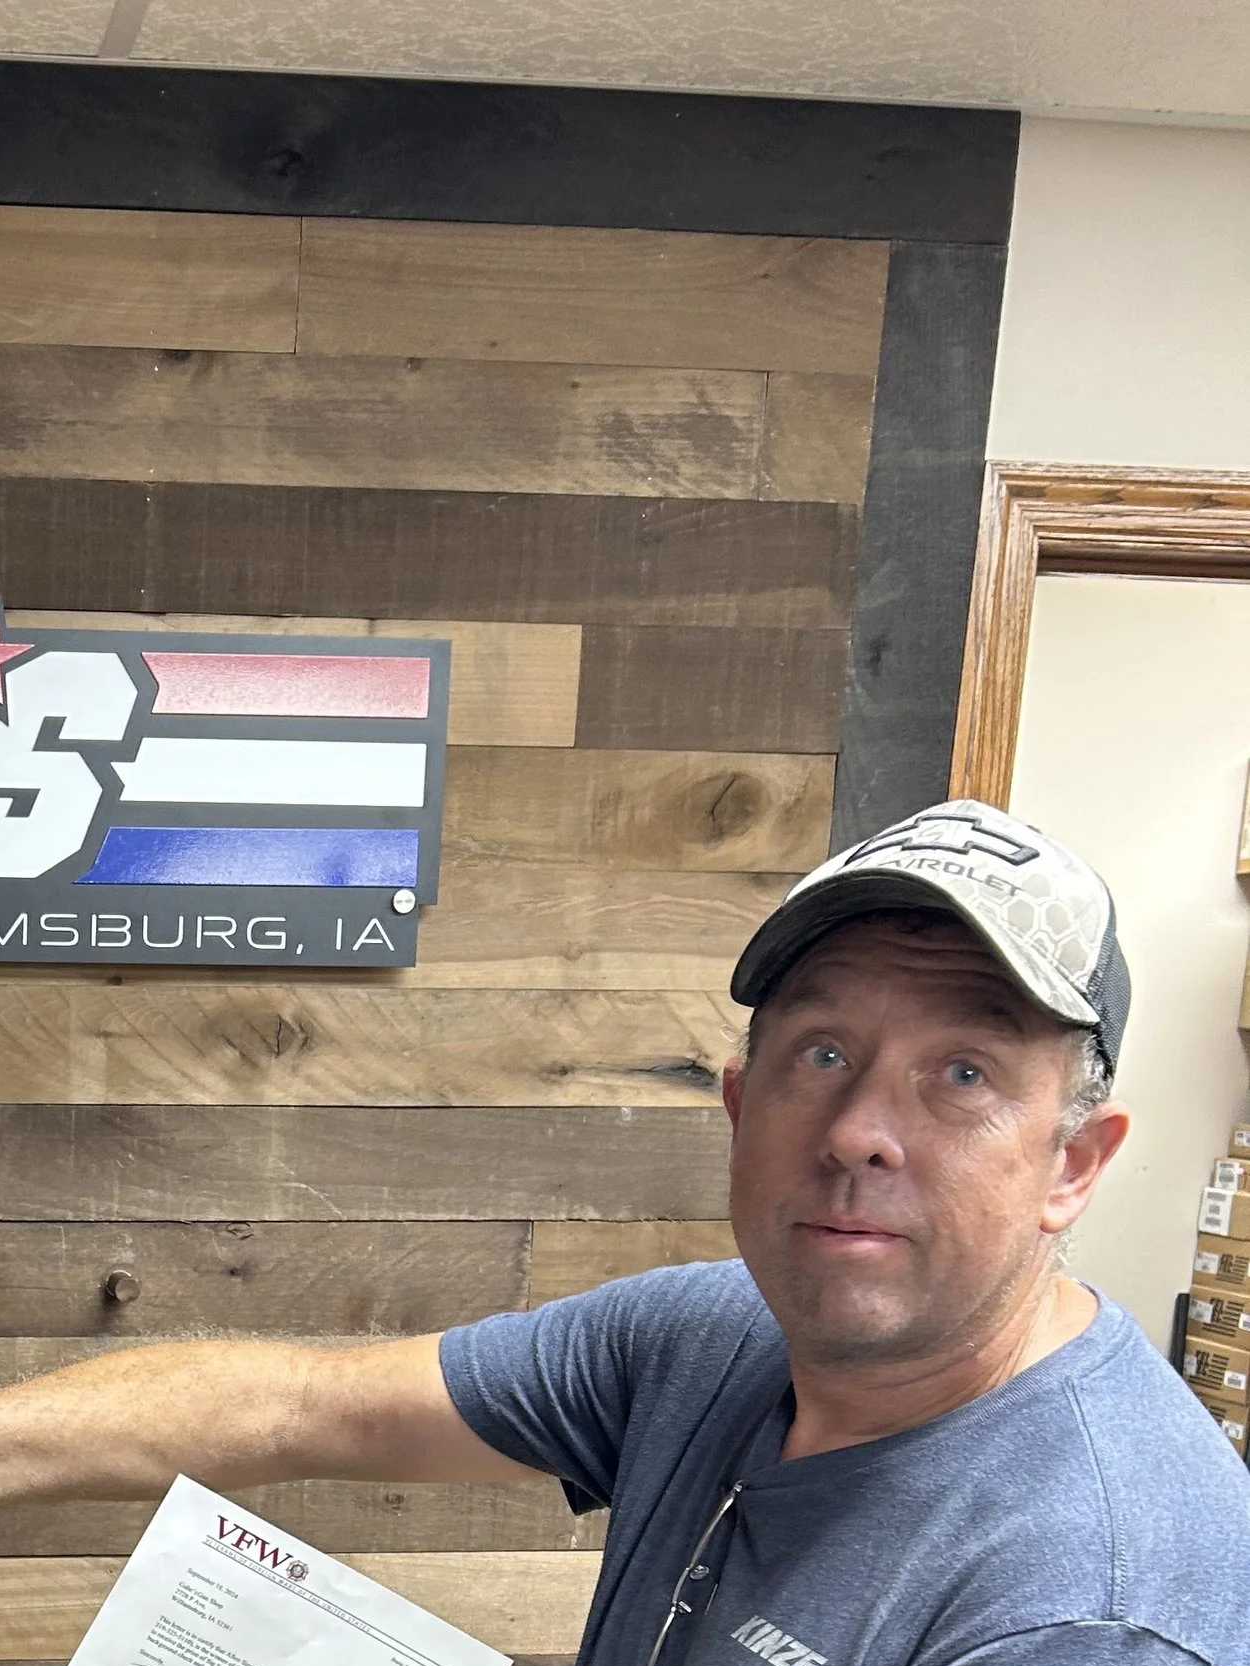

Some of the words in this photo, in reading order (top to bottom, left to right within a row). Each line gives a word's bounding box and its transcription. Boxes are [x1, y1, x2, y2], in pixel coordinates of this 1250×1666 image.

[333, 916, 396, 953] IA
[216, 1513, 294, 1571] VFW
[186, 1567, 215, 1586] September
[208, 1597, 223, 1609] Shop
[156, 1632, 176, 1645] receive
[170, 1621, 185, 1633] letter
[196, 1637, 215, 1649] certify
[176, 1652, 193, 1663] check
[209, 1652, 228, 1664] winner
